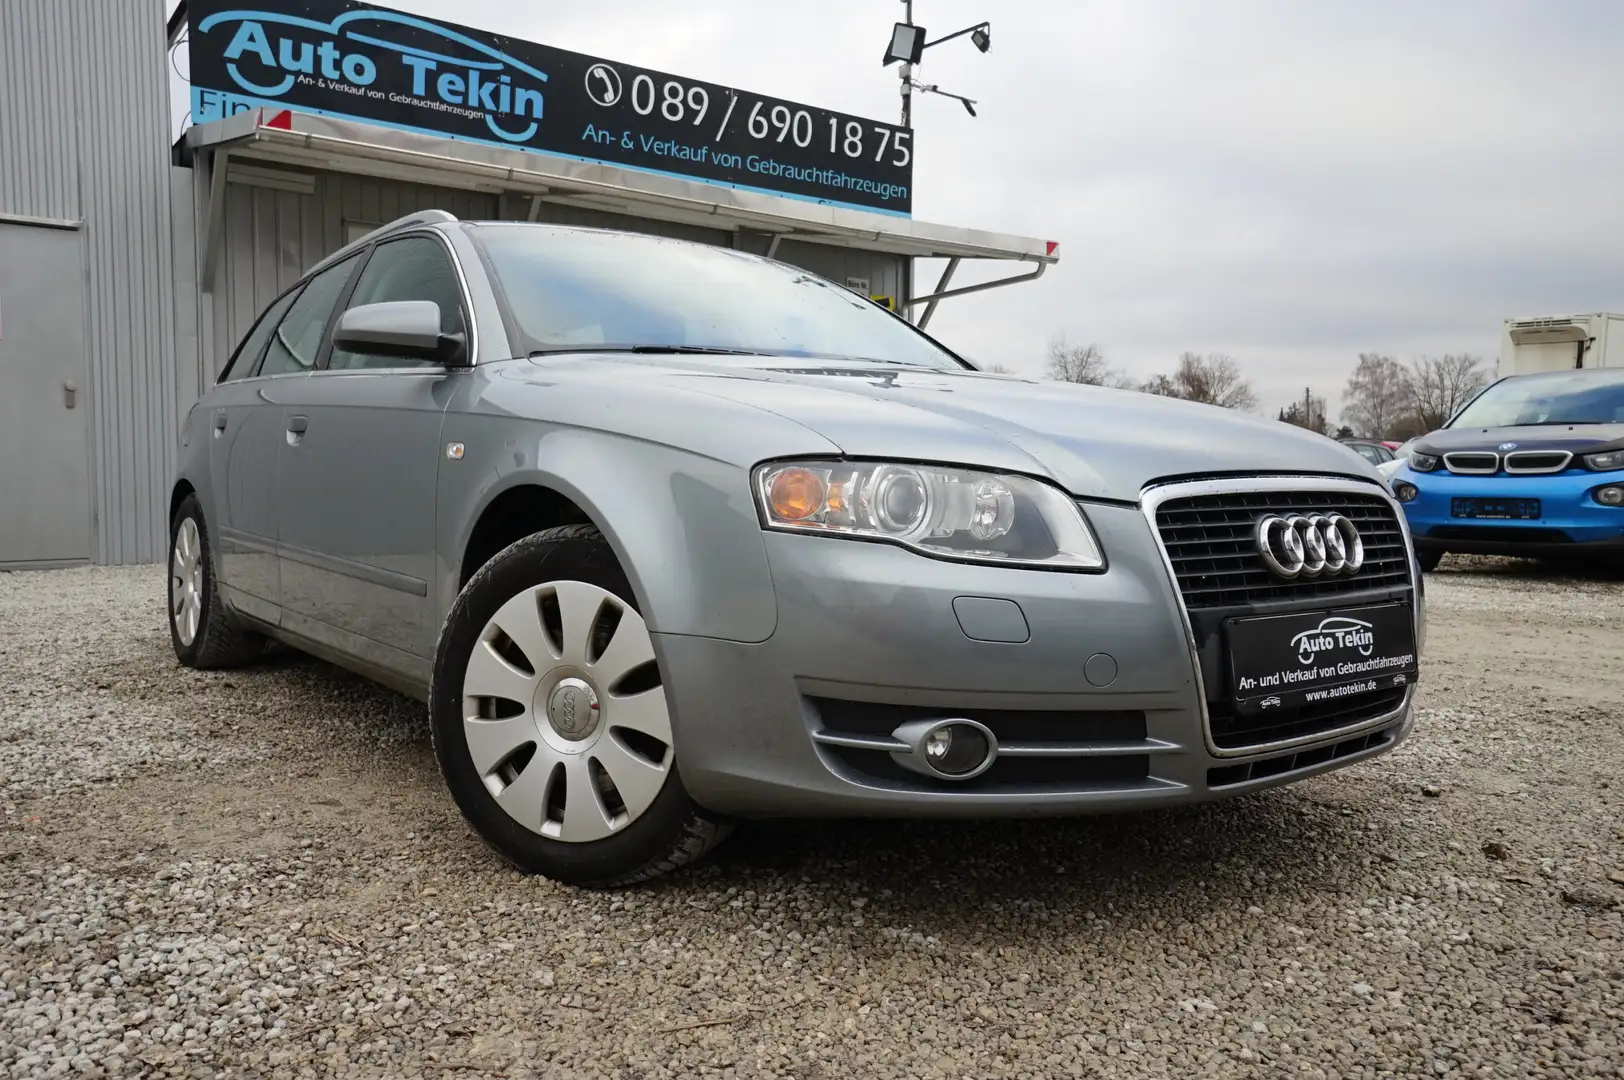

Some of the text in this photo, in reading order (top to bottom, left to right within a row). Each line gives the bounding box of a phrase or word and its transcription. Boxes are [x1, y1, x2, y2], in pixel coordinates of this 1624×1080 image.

[223, 21, 543, 119] Auto Tekin
[297, 74, 484, 119] An- & Verkauf von Gebrauchtfahrzeugen
[631, 74, 710, 126] 089
[748, 101, 813, 148] 690
[829, 117, 864, 158] 18
[874, 127, 910, 167] 75
[582, 123, 908, 200] An- & Verkauf von Gebrauchtfahrzeugen
[1299, 630, 1373, 653] Auto Tekin
[1239, 654, 1413, 690] An- und Verkauf von Gebrauchtfahrzeugen
[1306, 680, 1376, 701] www.autotekin.de
